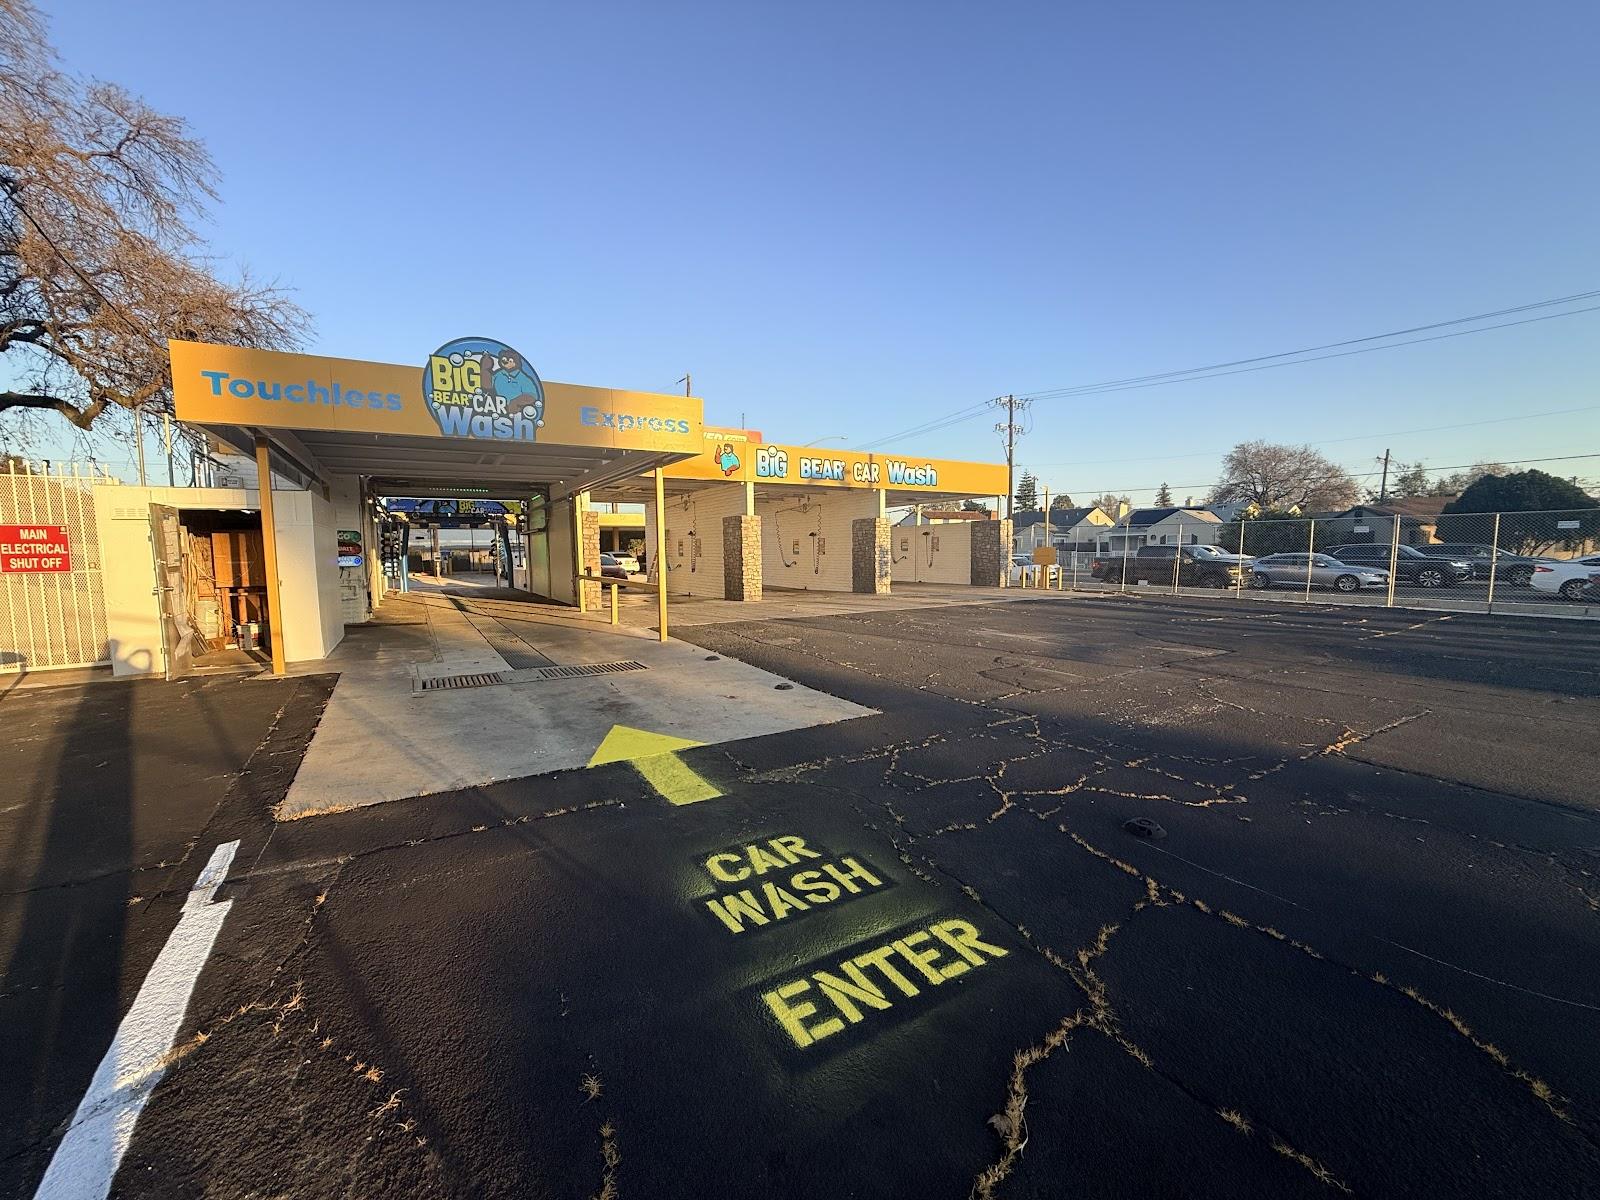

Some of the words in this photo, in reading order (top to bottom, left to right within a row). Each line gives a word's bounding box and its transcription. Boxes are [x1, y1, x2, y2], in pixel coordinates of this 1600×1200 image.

[201, 369, 403, 411] Touchless
[433, 391, 469, 407] BEAR
[472, 394, 507, 414] CAR
[437, 405, 534, 441] Wash
[580, 406, 690, 435] Express
[799, 457, 845, 481] BEAR
[853, 462, 880, 484] CAR
[887, 459, 937, 487] Wash
[1, 543, 69, 556] ELECTRICAL
[19, 528, 48, 541] MAIN
[9, 557, 39, 570] SHUT
[41, 556, 63, 569] OFF
[705, 835, 822, 883] CAR
[705, 856, 884, 935] WASH
[761, 917, 1010, 1049] ENTER
